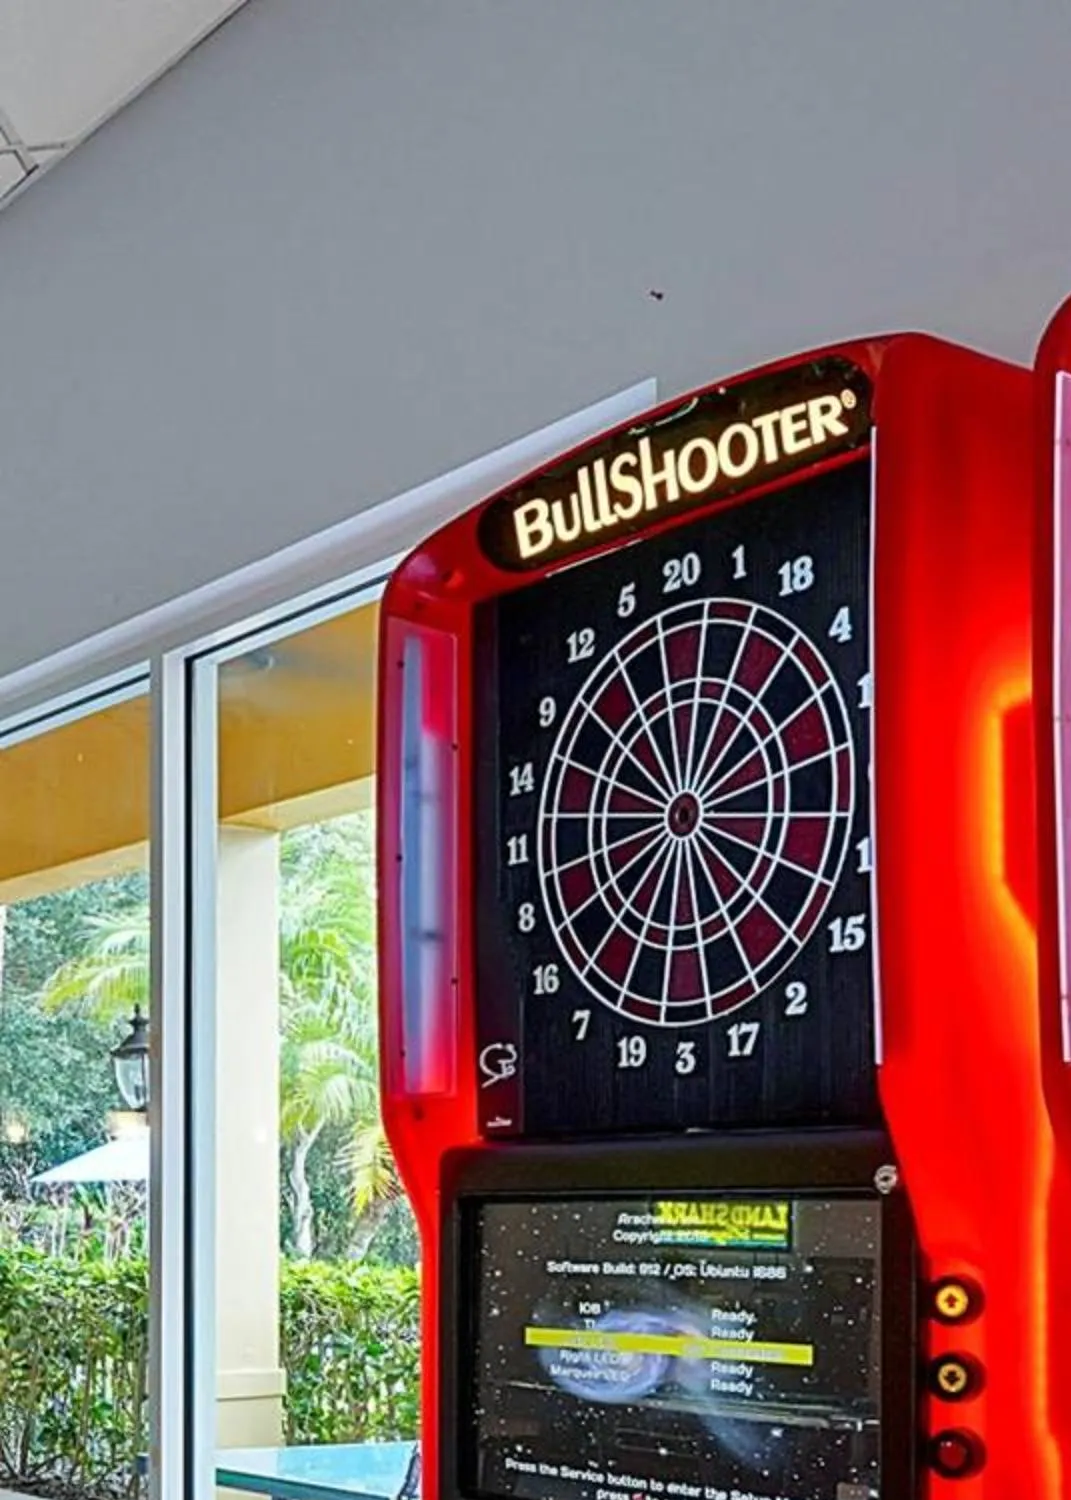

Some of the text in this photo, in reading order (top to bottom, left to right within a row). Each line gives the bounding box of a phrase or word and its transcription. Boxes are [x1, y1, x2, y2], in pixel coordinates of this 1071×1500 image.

[662, 552, 701, 593] 20
[732, 545, 747, 579] 1
[778, 555, 815, 597] 18
[616, 582, 636, 618] 5
[828, 606, 853, 643] 4
[566, 627, 596, 663] 12
[538, 696, 557, 727] 9
[508, 762, 535, 796] 14
[506, 835, 529, 866] 11
[517, 902, 536, 933] 8
[827, 914, 867, 953] 15
[532, 963, 560, 996] 16
[784, 981, 808, 1016] 2
[571, 1009, 591, 1041] 7
[727, 1022, 760, 1057] 17
[617, 1035, 647, 1068] 19
[675, 1041, 697, 1074] 3
[711, 1308, 753, 1325] Ready
[711, 1326, 755, 1343] Ready
[711, 1361, 754, 1378] Ready
[710, 1378, 754, 1396] Ready
[505, 1457, 537, 1473] Press
[539, 1460, 558, 1476] the
[560, 1465, 605, 1484] Service
[607, 1472, 647, 1490] button
[650, 1476, 664, 1492] to
[667, 1481, 701, 1498] enter
